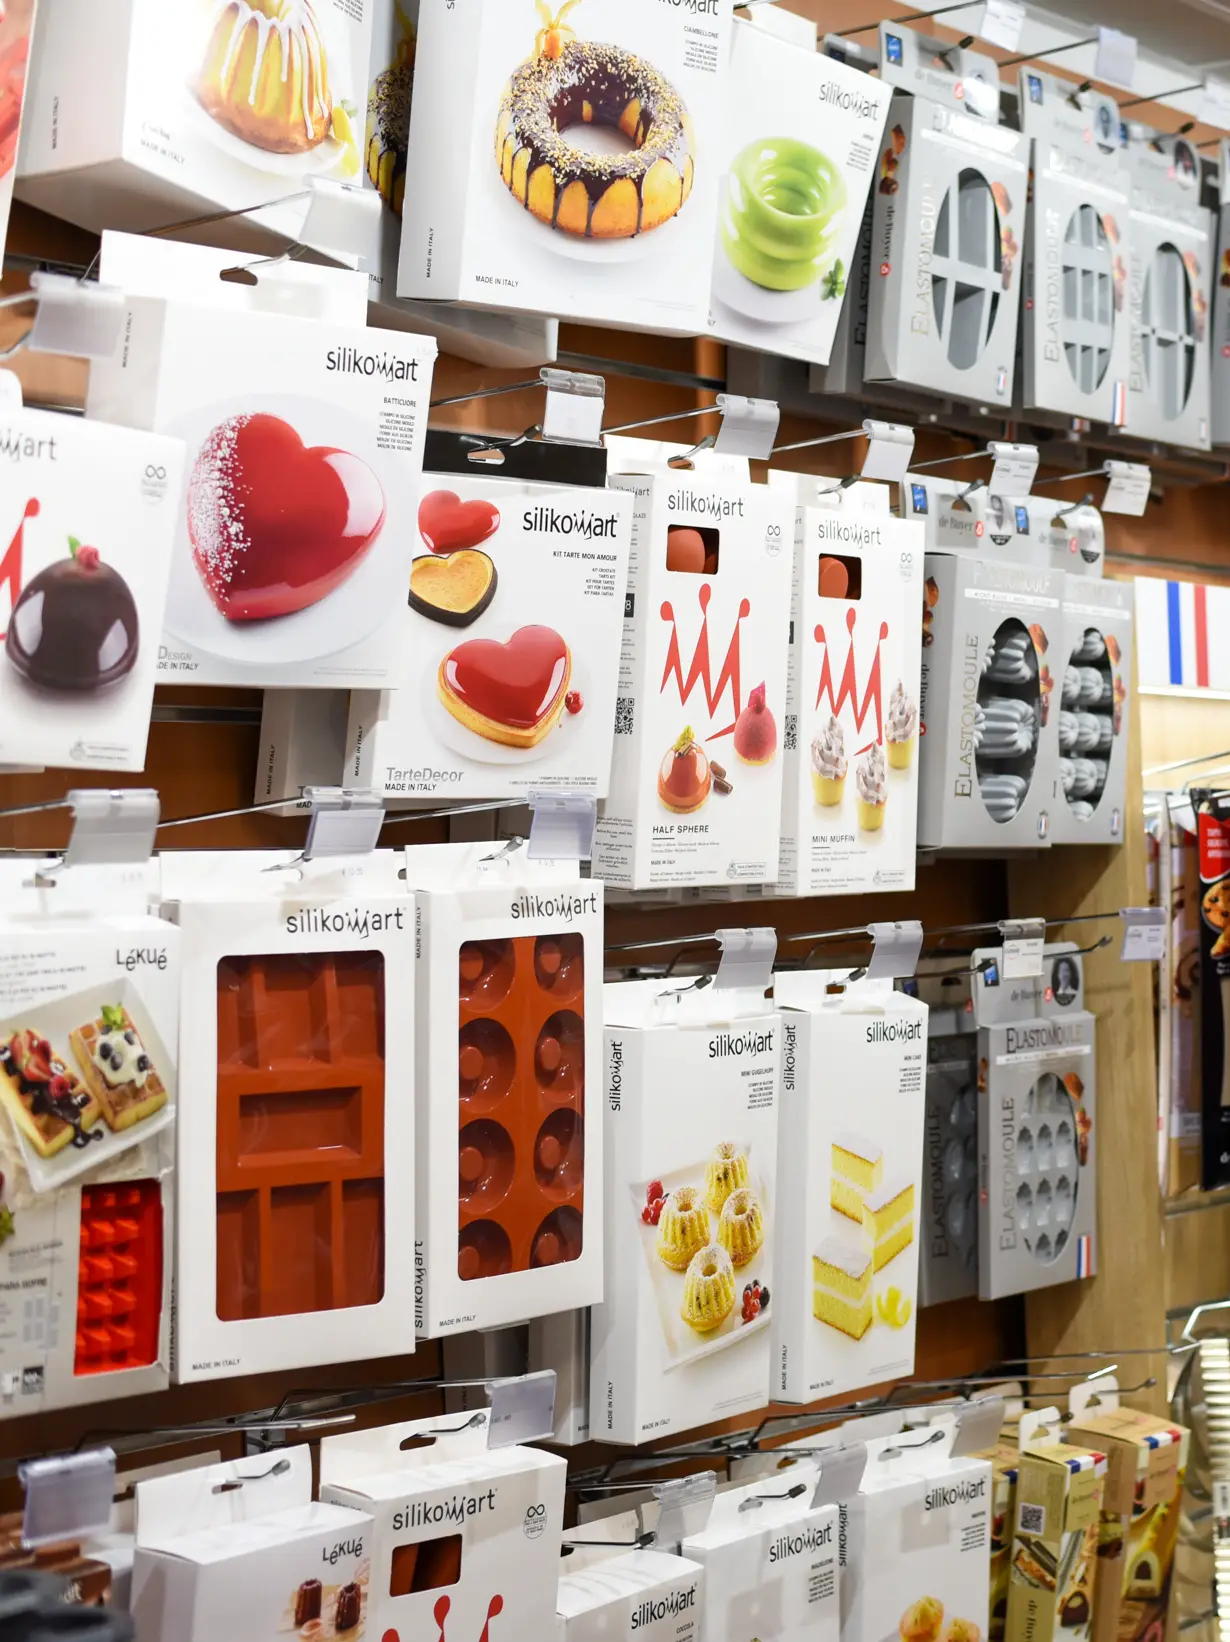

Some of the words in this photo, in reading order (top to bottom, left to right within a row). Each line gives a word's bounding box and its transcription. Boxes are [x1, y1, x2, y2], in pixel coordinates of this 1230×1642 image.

[684, 26, 718, 39] CIAMBELLONE
[476, 275, 494, 285] MADE
[502, 278, 519, 287] ITALY
[326, 346, 419, 383] silikomart
[384, 396, 416, 407] BATTICUORE
[668, 490, 744, 522] silikomart
[523, 506, 618, 540] silikomart
[818, 522, 881, 550] silikomart
[939, 516, 949, 528] de
[921, 664, 930, 679] de
[954, 634, 978, 799] ELASTOMOULE
[386, 767, 464, 782] TarteDecor
[677, 825, 709, 833] SPHERE
[511, 892, 597, 922] silikomart
[286, 907, 404, 940] silikomart
[709, 1031, 773, 1058] silikomart
[866, 1019, 921, 1045] silikomart
[1006, 1024, 1083, 1054] ELASTOMOULE
[784, 1024, 797, 1090] silikomart
[611, 1040, 623, 1111] silikomart
[192, 1362, 212, 1371] MADE
[222, 1358, 241, 1367] ITALY
[925, 1478, 985, 1511] silikomart
[393, 1489, 496, 1531] silikomart
[770, 1524, 832, 1563] silikomart
[631, 1585, 695, 1630] silikomart
